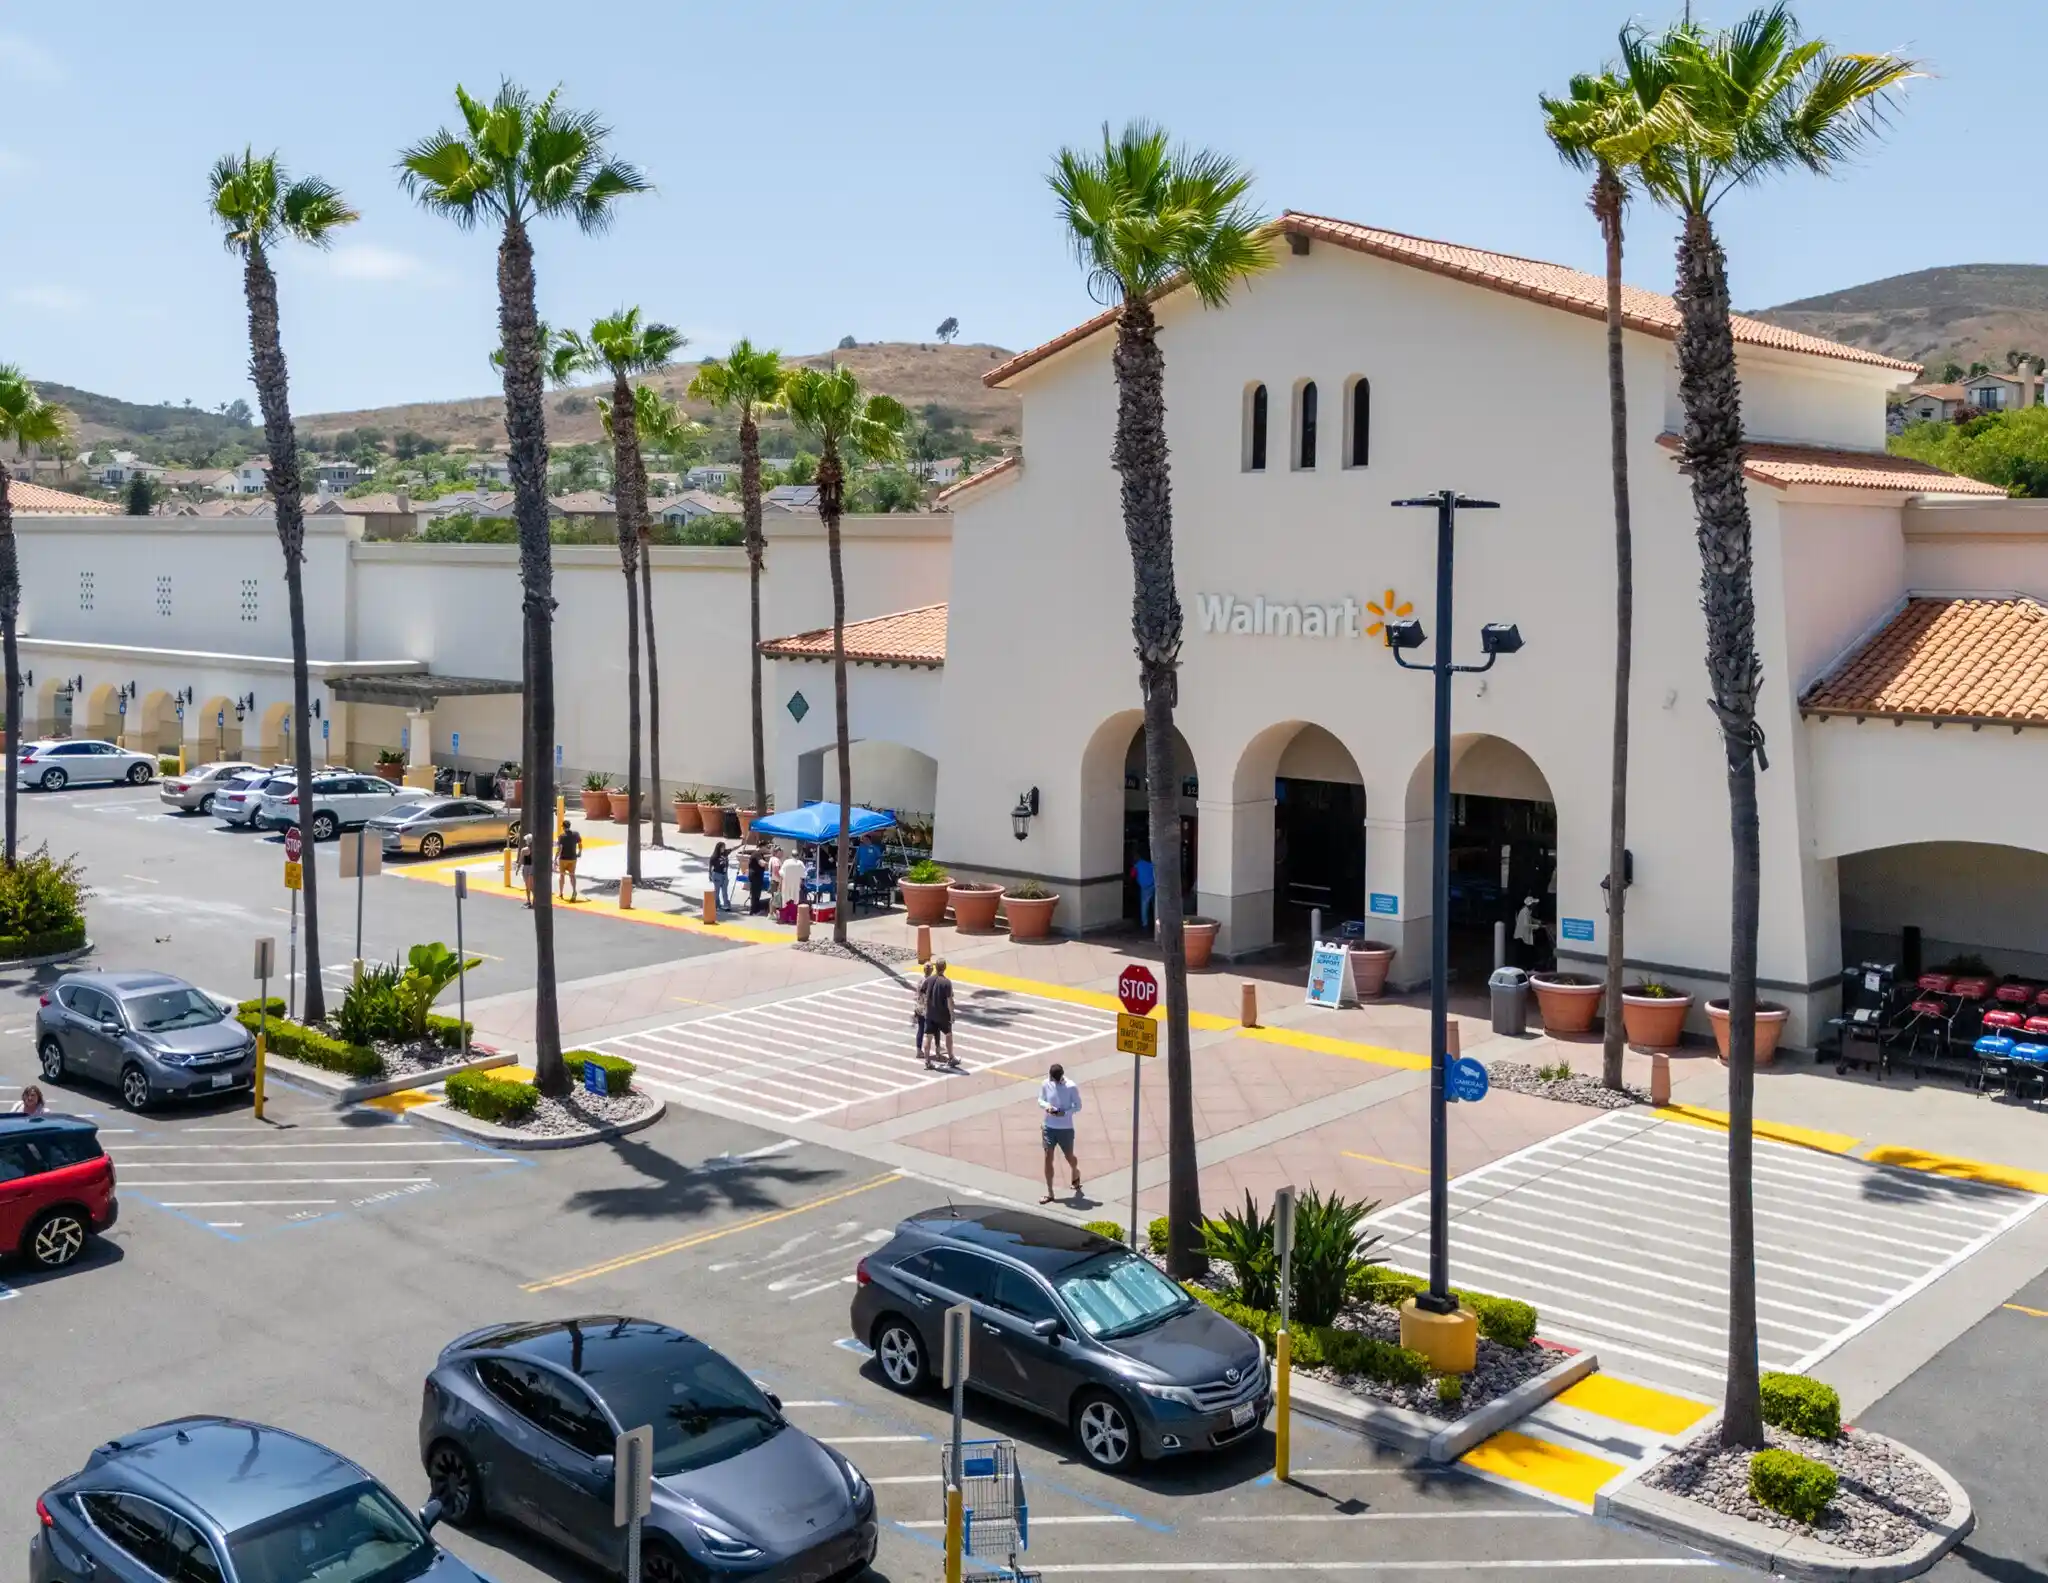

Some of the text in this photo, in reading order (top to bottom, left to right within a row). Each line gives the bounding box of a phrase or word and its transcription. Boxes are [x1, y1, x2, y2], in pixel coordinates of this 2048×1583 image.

[1196, 593, 1361, 638] Walmart
[287, 839, 301, 852] STOP
[1121, 978, 1155, 1001] STOP
[1129, 1019, 1145, 1030] CROSS
[1455, 1079, 1485, 1088] CAMERAS
